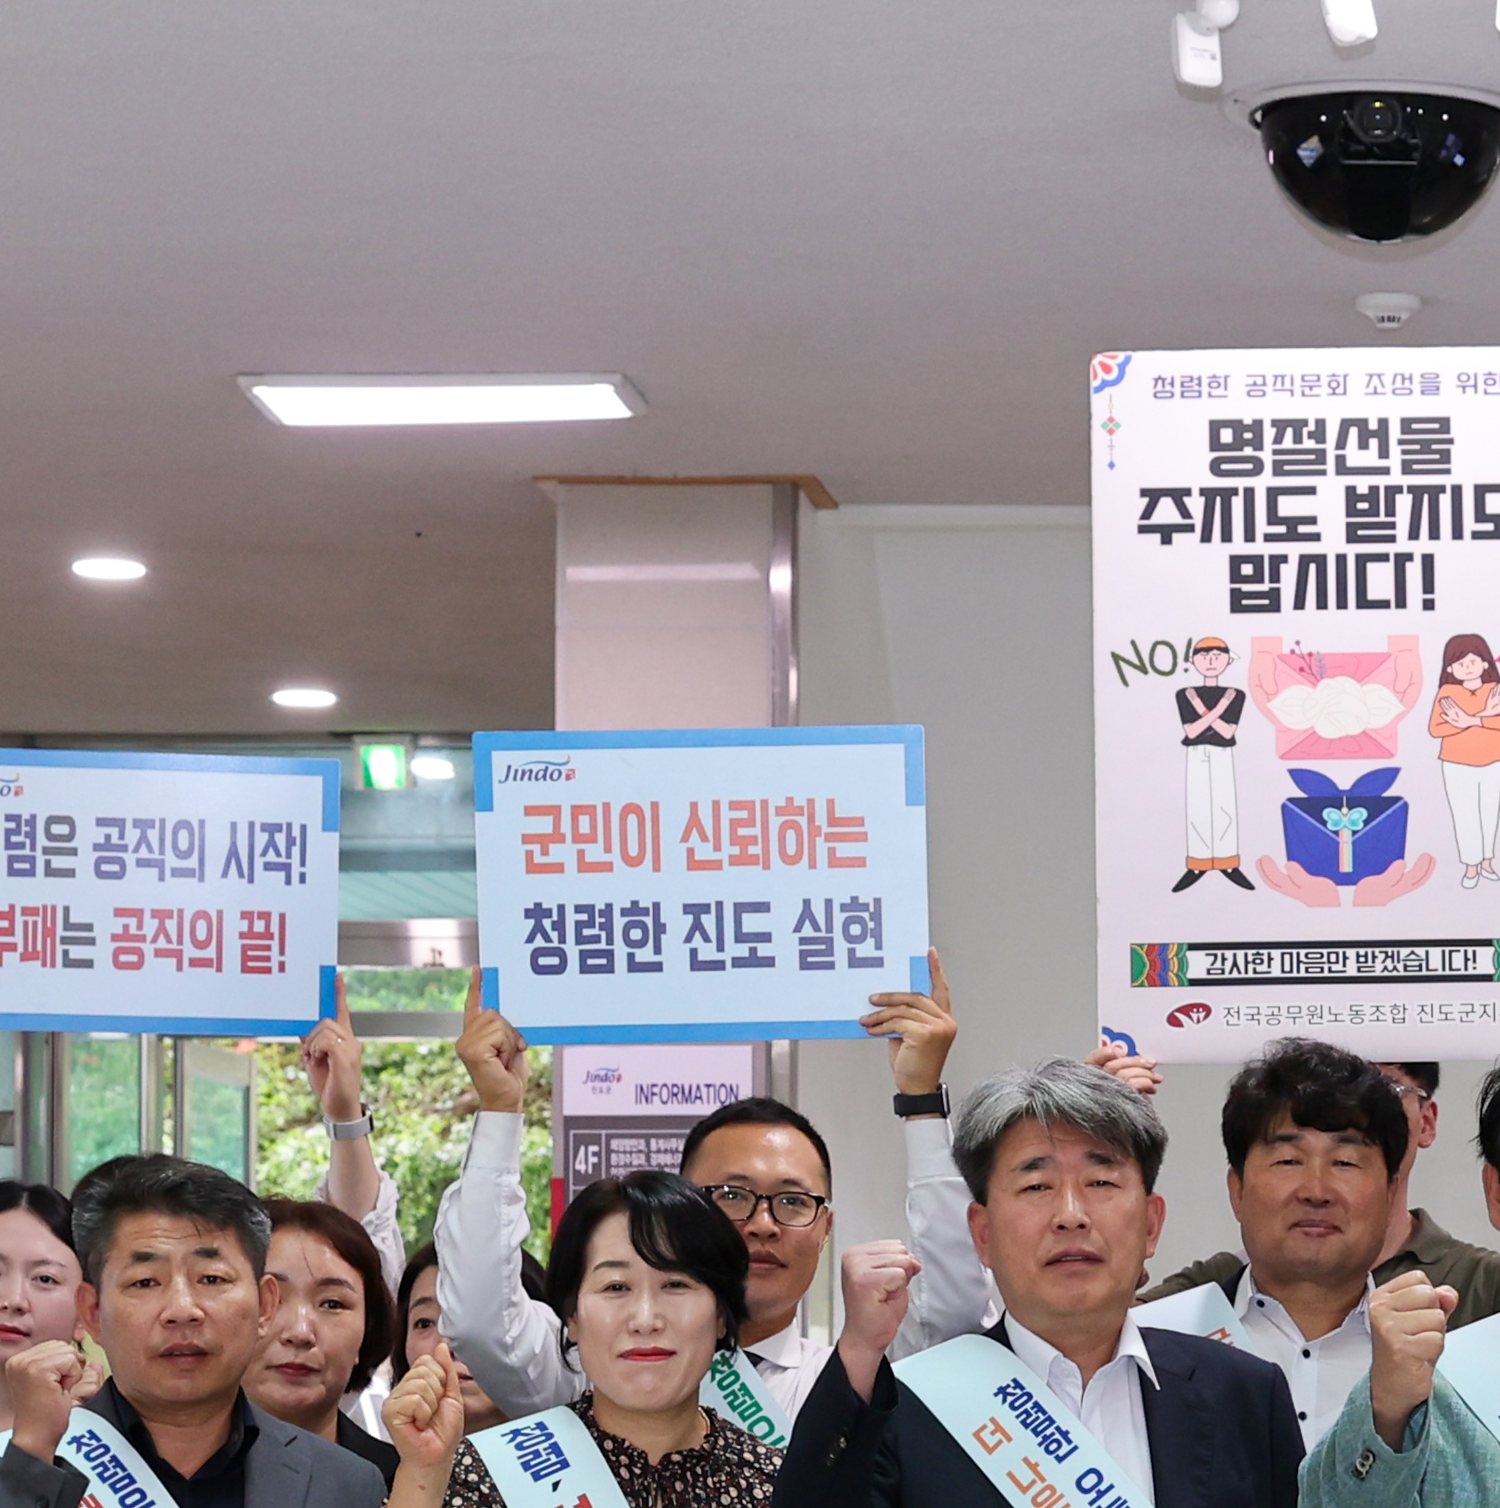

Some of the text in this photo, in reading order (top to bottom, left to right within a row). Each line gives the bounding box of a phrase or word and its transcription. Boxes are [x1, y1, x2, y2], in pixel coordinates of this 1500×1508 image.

[1152, 373, 1231, 400] 청렴한
[1244, 371, 1348, 398] 공직문화
[1364, 370, 1442, 397] 조성을
[1208, 416, 1454, 478] 명절선물
[1137, 485, 1321, 545] 주지도
[1229, 552, 1435, 614] 맙시다!
[1111, 637, 1192, 687] NO!
[92, 816, 206, 883] 공직의
[221, 820, 309, 887] 시작!
[520, 798, 869, 876] 군민이 신뢰하는
[110, 907, 224, 974] 공직의
[237, 909, 288, 976] 끝!
[523, 895, 887, 977] 청렴한 진도 실현
[1204, 948, 1479, 978] 감사한 마음만 받겠습니다!
[1222, 1002, 1408, 1028] 전국공무원노동조합
[583, 1070, 617, 1085] Jindo
[634, 1083, 740, 1105] INFORMATION
[575, 1145, 600, 1174] 4F
